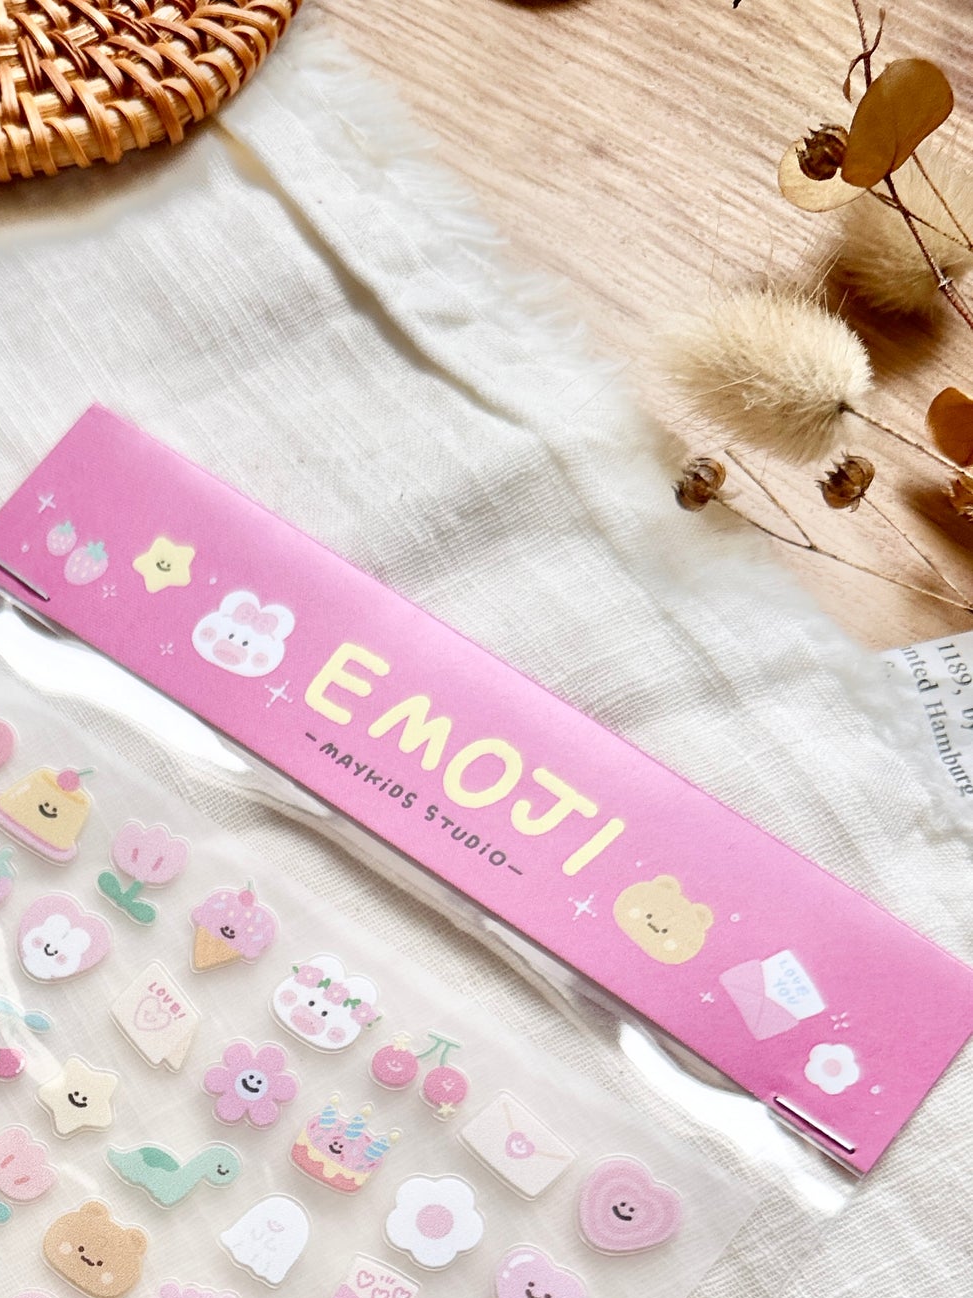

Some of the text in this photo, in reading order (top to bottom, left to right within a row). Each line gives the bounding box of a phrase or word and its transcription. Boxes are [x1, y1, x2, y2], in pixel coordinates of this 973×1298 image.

[938, 643, 973, 696] 1189,
[304, 642, 626, 877] EMOJI
[773, 978, 801, 1005] YOU
[778, 959, 810, 996] LOVE
[148, 981, 187, 1021] LOVE!
